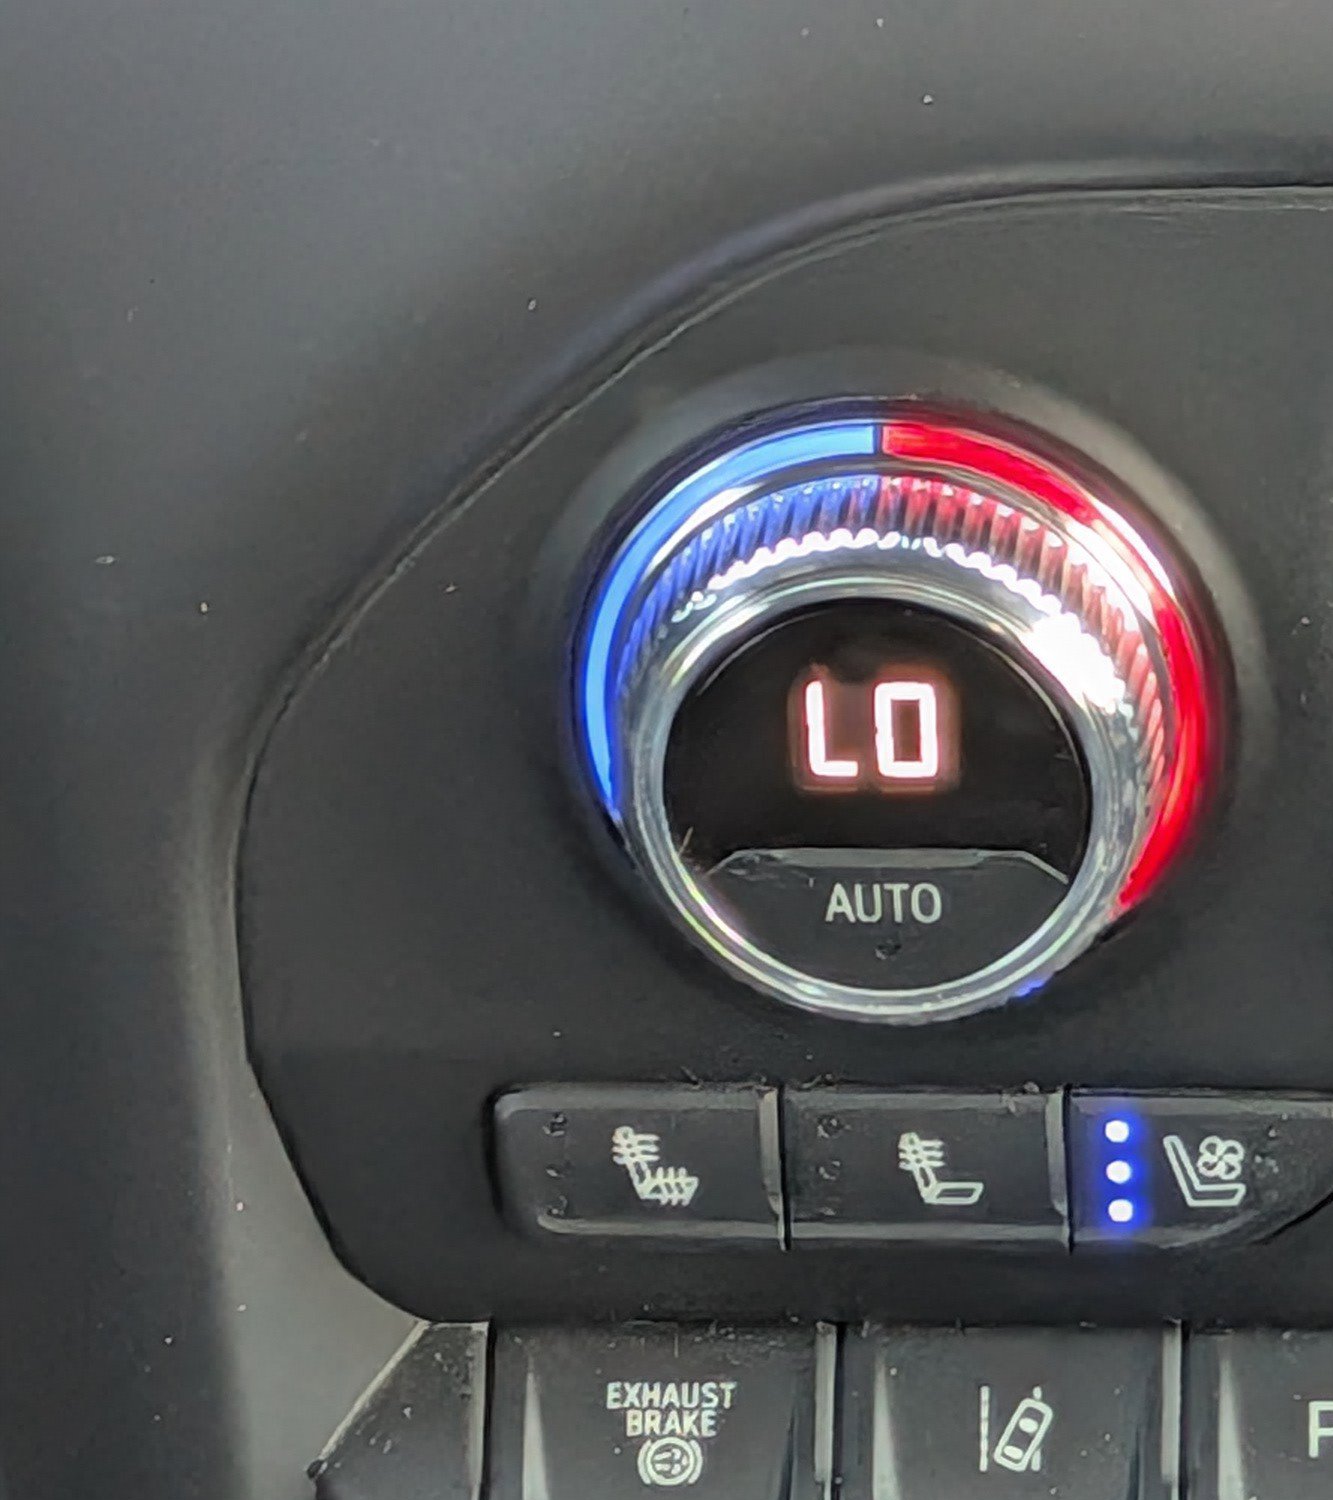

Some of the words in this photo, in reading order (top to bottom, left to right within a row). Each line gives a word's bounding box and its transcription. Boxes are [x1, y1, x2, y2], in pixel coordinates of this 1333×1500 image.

[805, 680, 939, 778] LO
[824, 882, 943, 924] AUTO
[605, 1380, 739, 1410] EXHAUST
[625, 1408, 718, 1438] BRAKE
